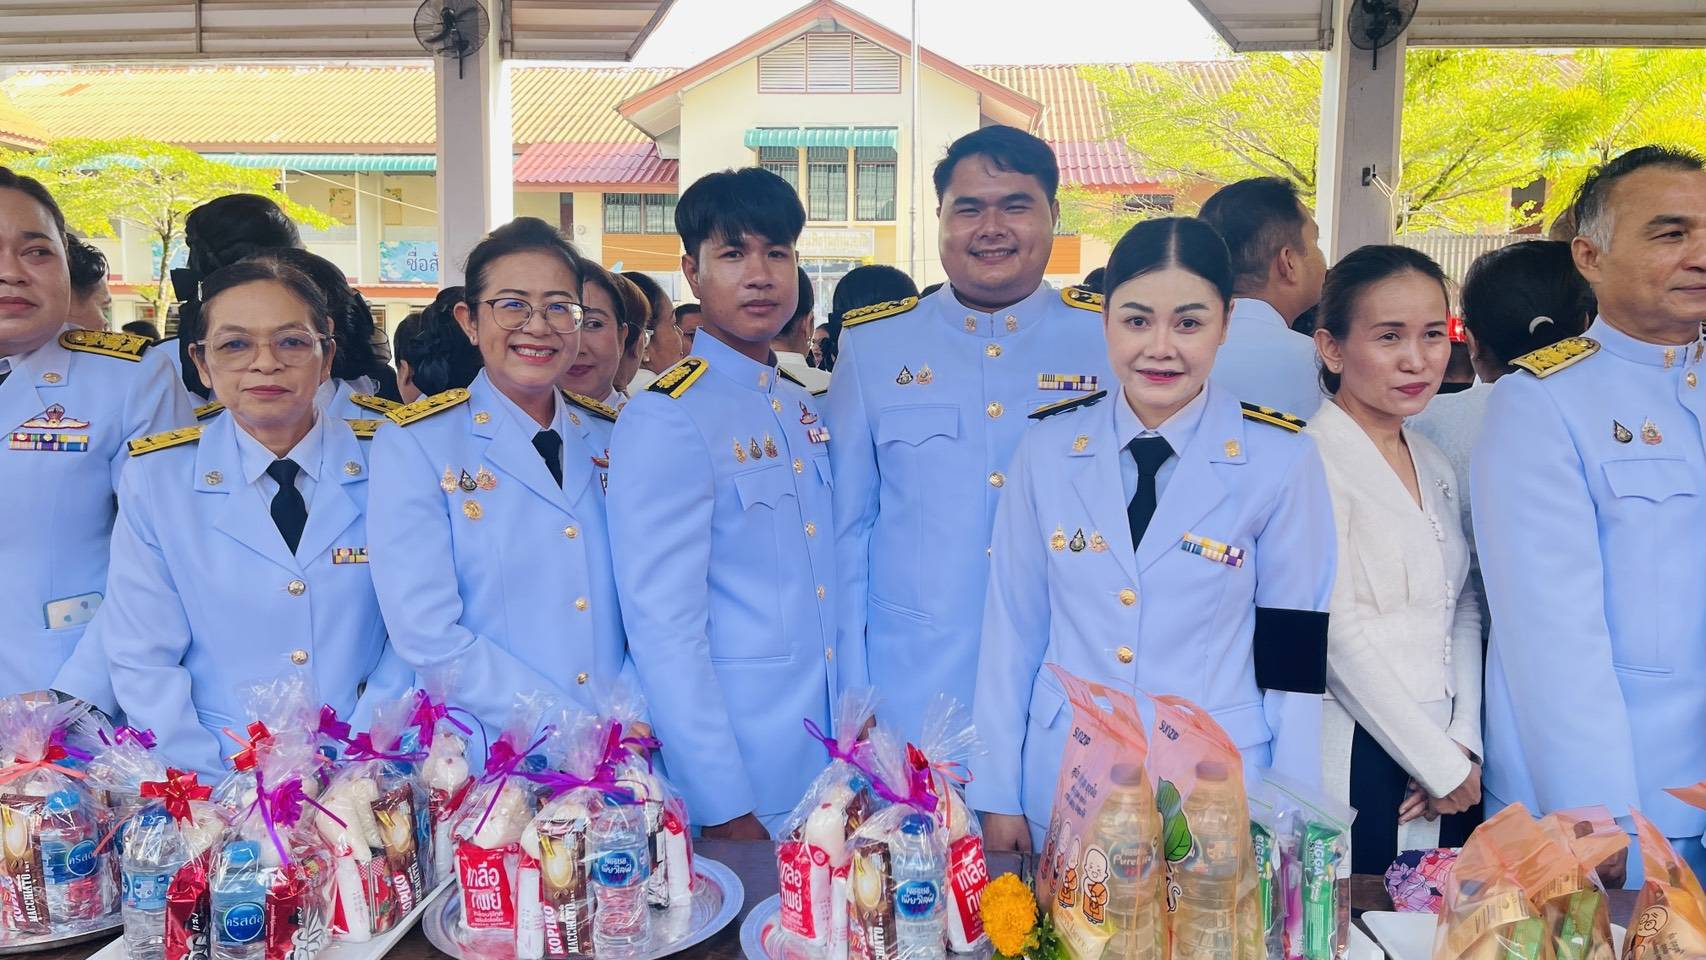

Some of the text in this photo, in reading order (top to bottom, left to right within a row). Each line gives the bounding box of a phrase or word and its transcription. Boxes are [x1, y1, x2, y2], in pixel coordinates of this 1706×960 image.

[466, 861, 500, 888] เกลือ
[227, 913, 263, 927] คริสตัล
[543, 905, 564, 955] KOPIKO
